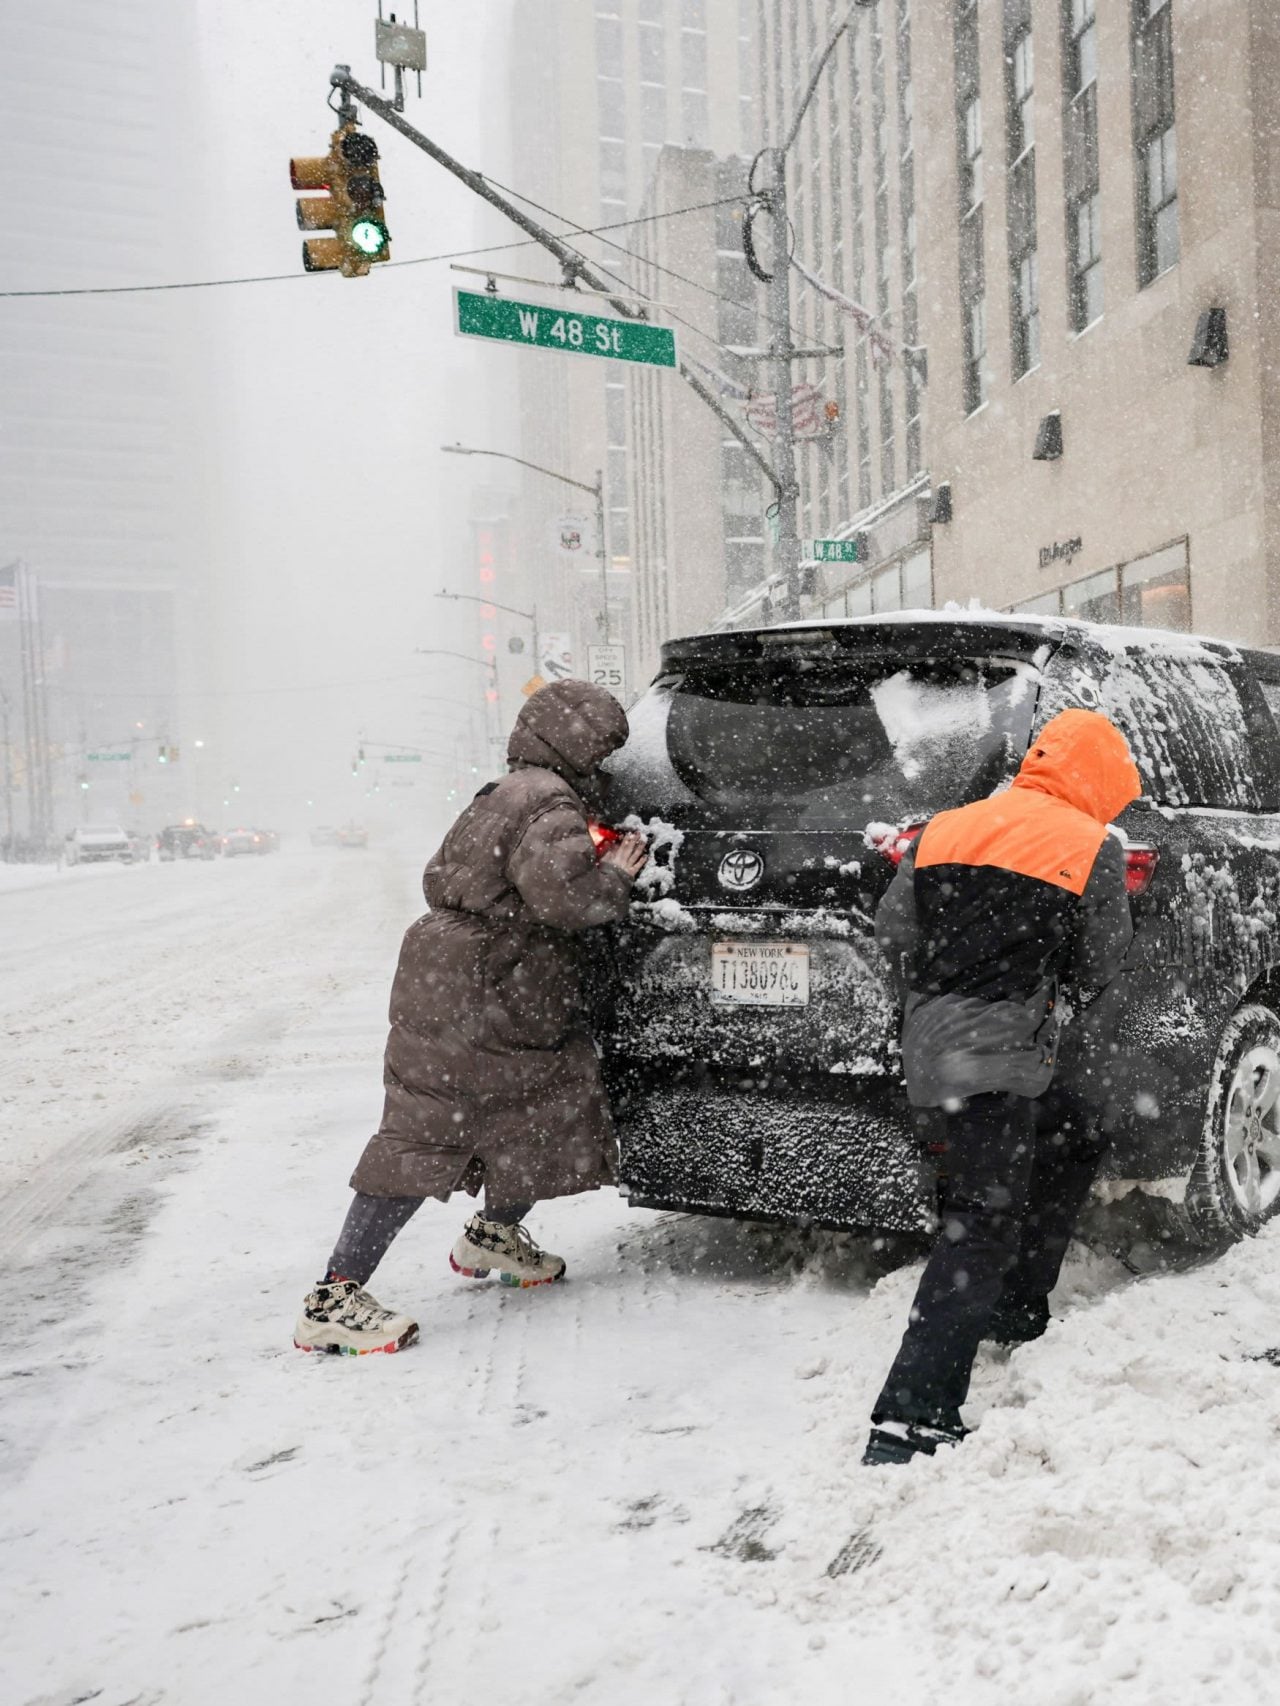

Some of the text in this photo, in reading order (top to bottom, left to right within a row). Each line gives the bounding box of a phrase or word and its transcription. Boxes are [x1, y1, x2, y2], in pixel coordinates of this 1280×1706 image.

[518, 309, 622, 353] W 48 St
[814, 542, 825, 560] W
[828, 542, 843, 560] 48
[593, 669, 622, 686] 25
[737, 947, 784, 959] NEW YORK
